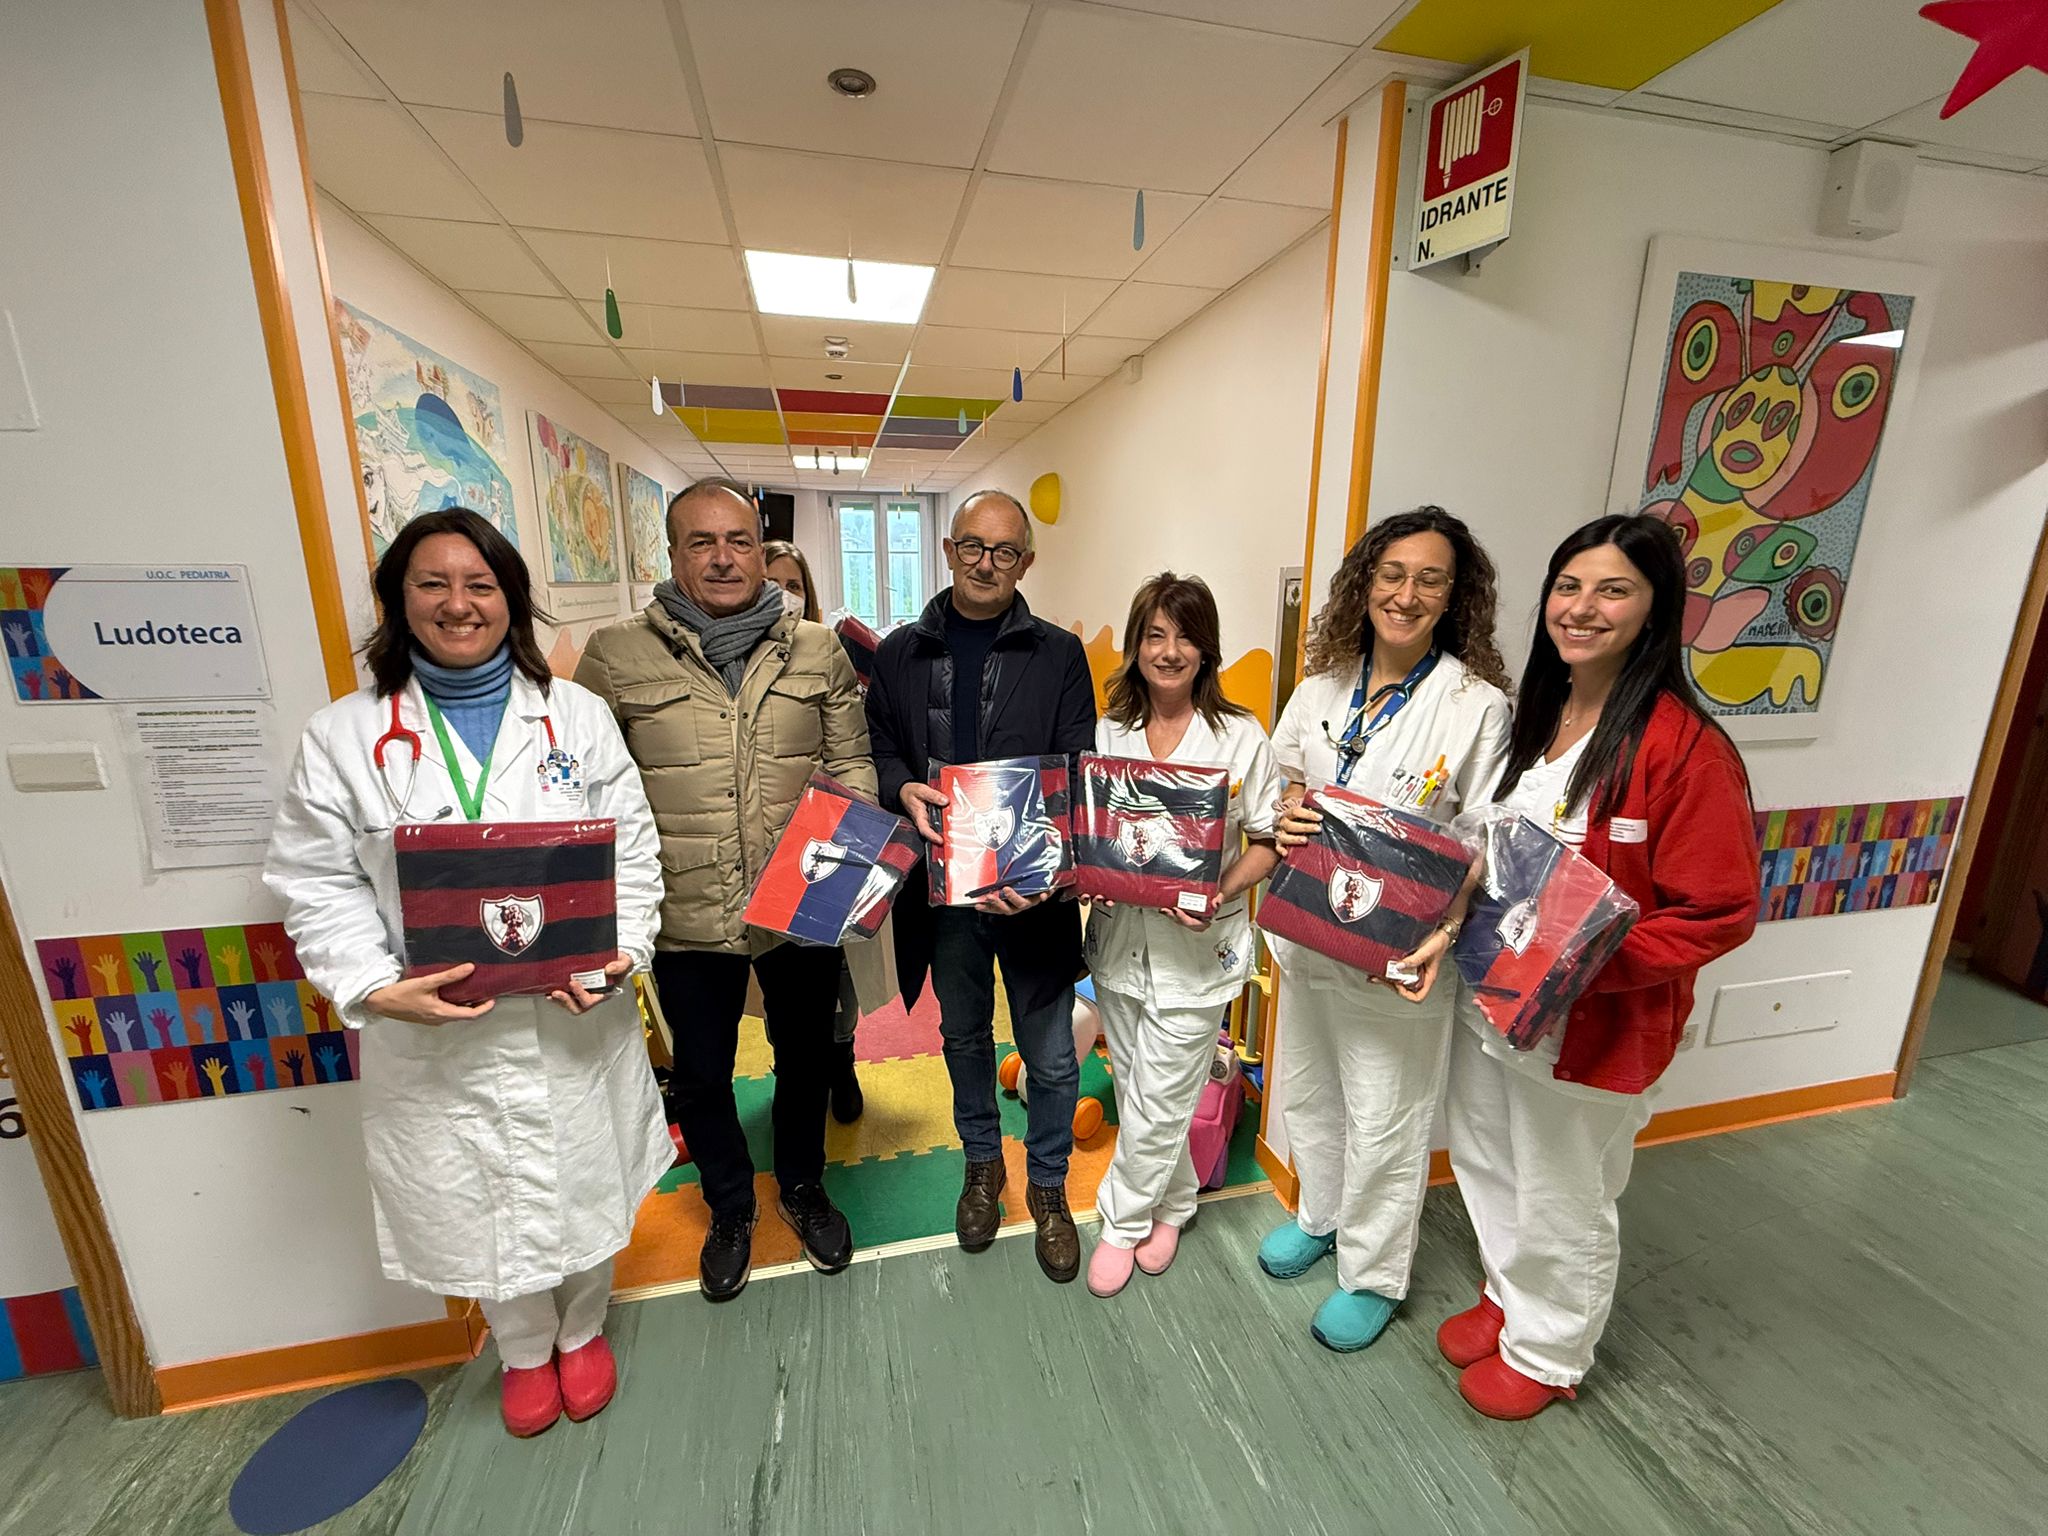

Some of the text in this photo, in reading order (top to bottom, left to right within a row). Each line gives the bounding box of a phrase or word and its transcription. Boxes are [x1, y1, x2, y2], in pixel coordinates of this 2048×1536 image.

[1420, 176, 1508, 232] IDRANTE
[1417, 239, 1435, 262] N.
[145, 570, 231, 579] U.O.C. PEDIATRIA
[94, 620, 242, 645] Ludoteca
